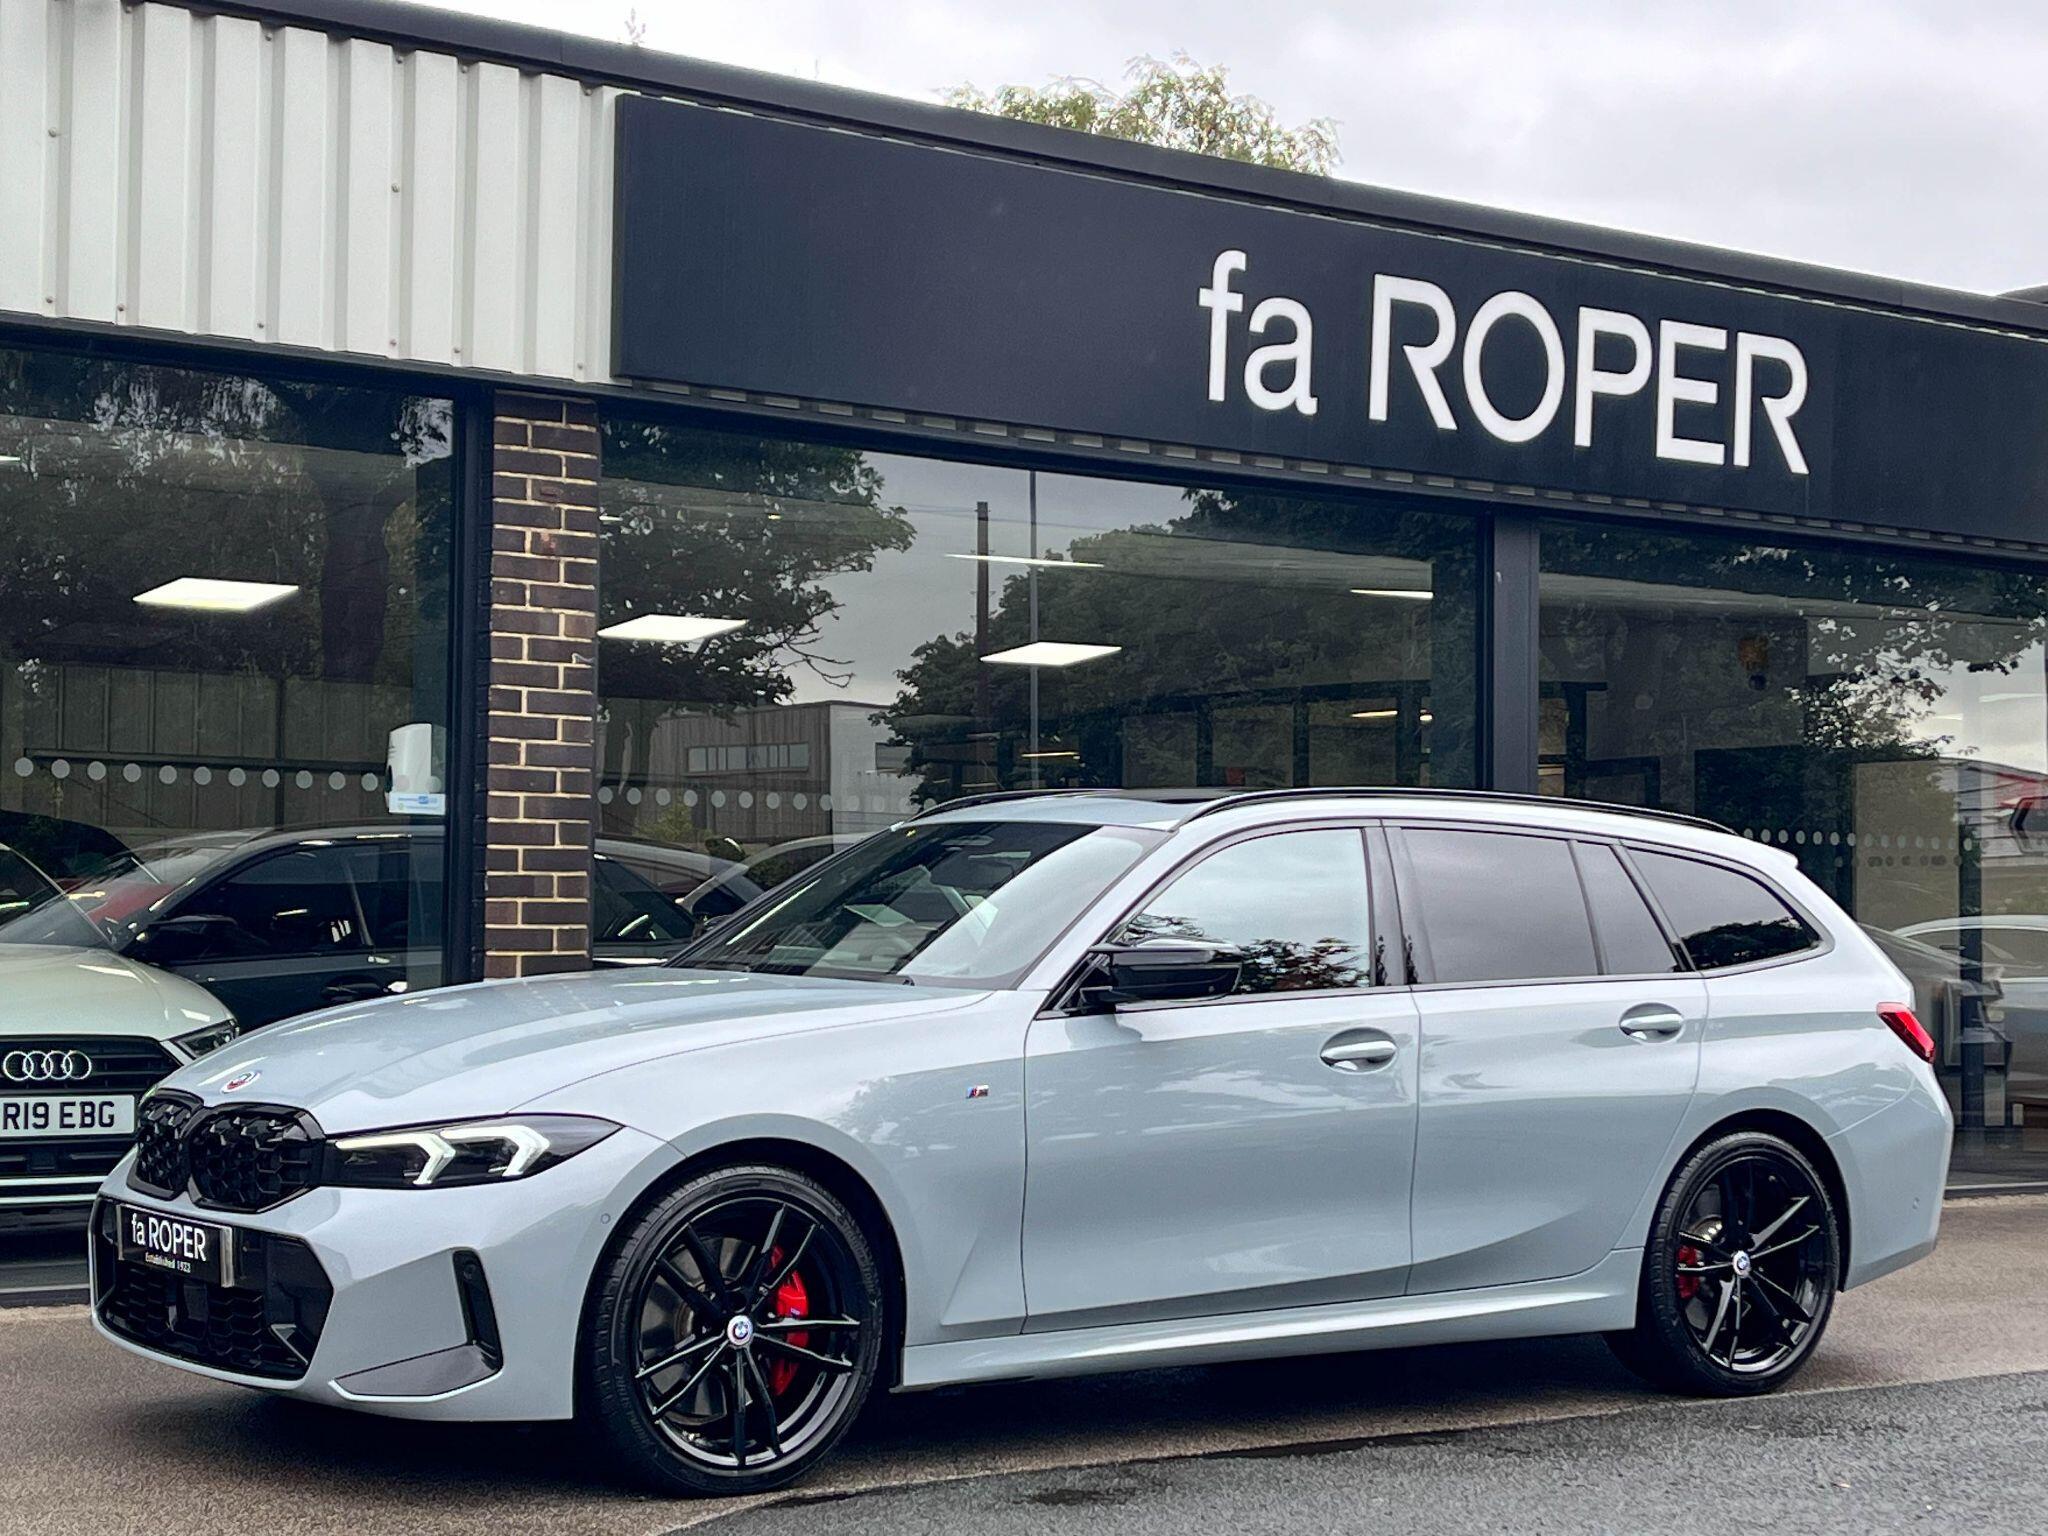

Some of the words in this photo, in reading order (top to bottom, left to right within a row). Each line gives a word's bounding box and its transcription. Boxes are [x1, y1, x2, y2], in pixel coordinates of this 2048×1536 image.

[1199, 249, 1318, 416] fa
[1368, 273, 1810, 475] ROPER
[3, 1101, 49, 1130] R19
[59, 1101, 115, 1129] EBG
[131, 1212, 146, 1246] fa
[148, 1216, 207, 1262] ROPER
